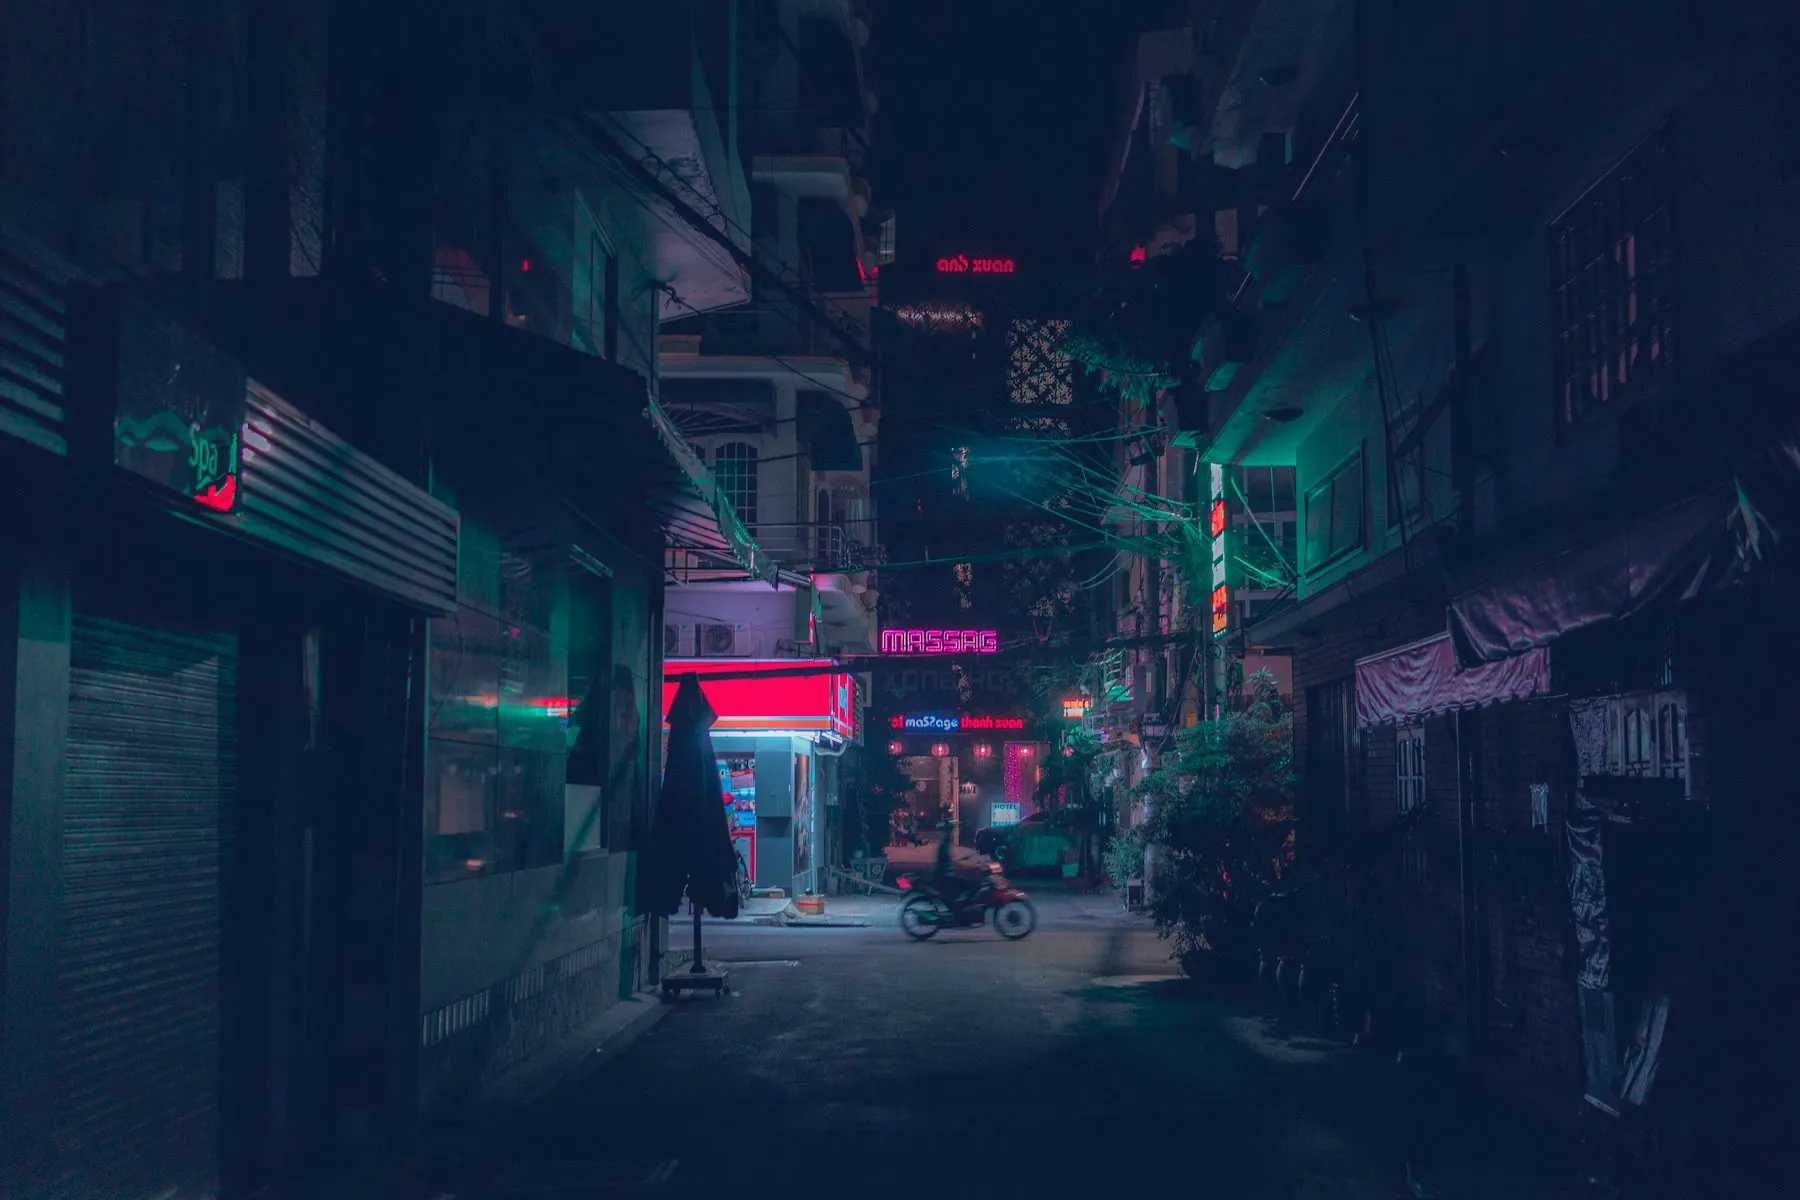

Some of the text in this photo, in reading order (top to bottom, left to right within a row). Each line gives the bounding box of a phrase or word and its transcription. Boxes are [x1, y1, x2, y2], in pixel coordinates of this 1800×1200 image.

[972, 258, 1014, 273] xuan
[188, 421, 218, 481] Spa
[881, 629, 997, 653] MASSAG
